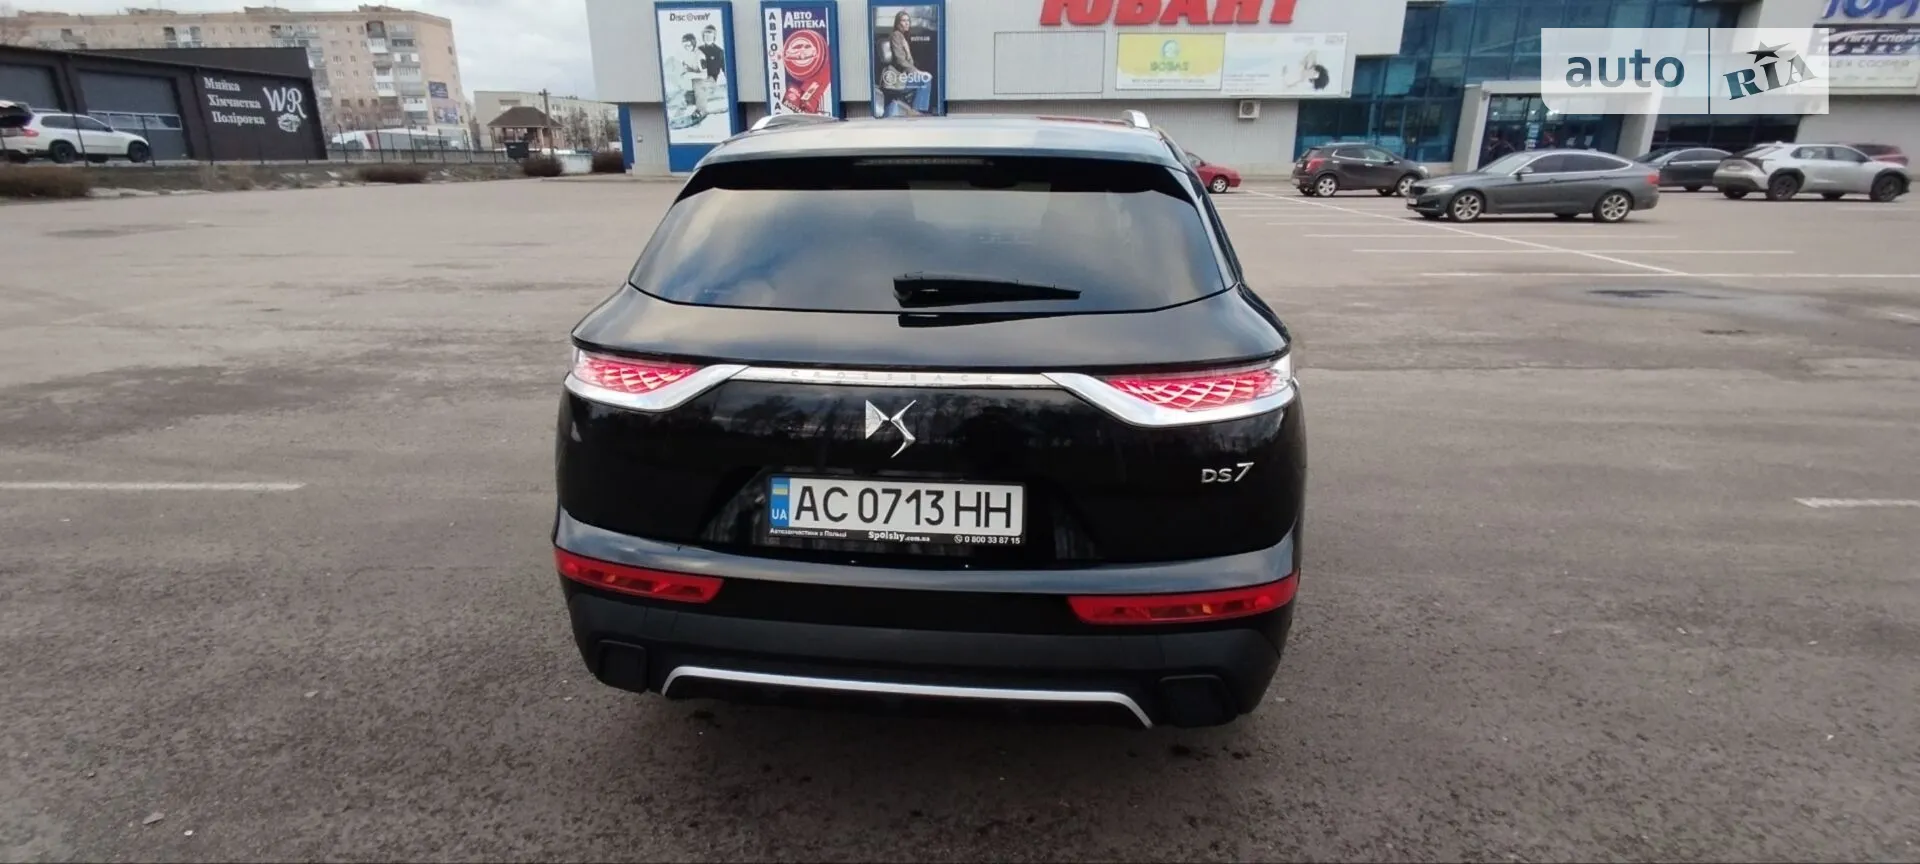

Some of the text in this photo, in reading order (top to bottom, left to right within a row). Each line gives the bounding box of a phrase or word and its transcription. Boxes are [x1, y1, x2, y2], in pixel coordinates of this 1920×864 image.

[203, 76, 241, 92] Мийка
[207, 94, 262, 109] Хімчистка
[262, 86, 308, 119] WR
[211, 111, 266, 126] Поліровка
[771, 508, 788, 520] UA
[794, 485, 1012, 528] AC 0713 HH
